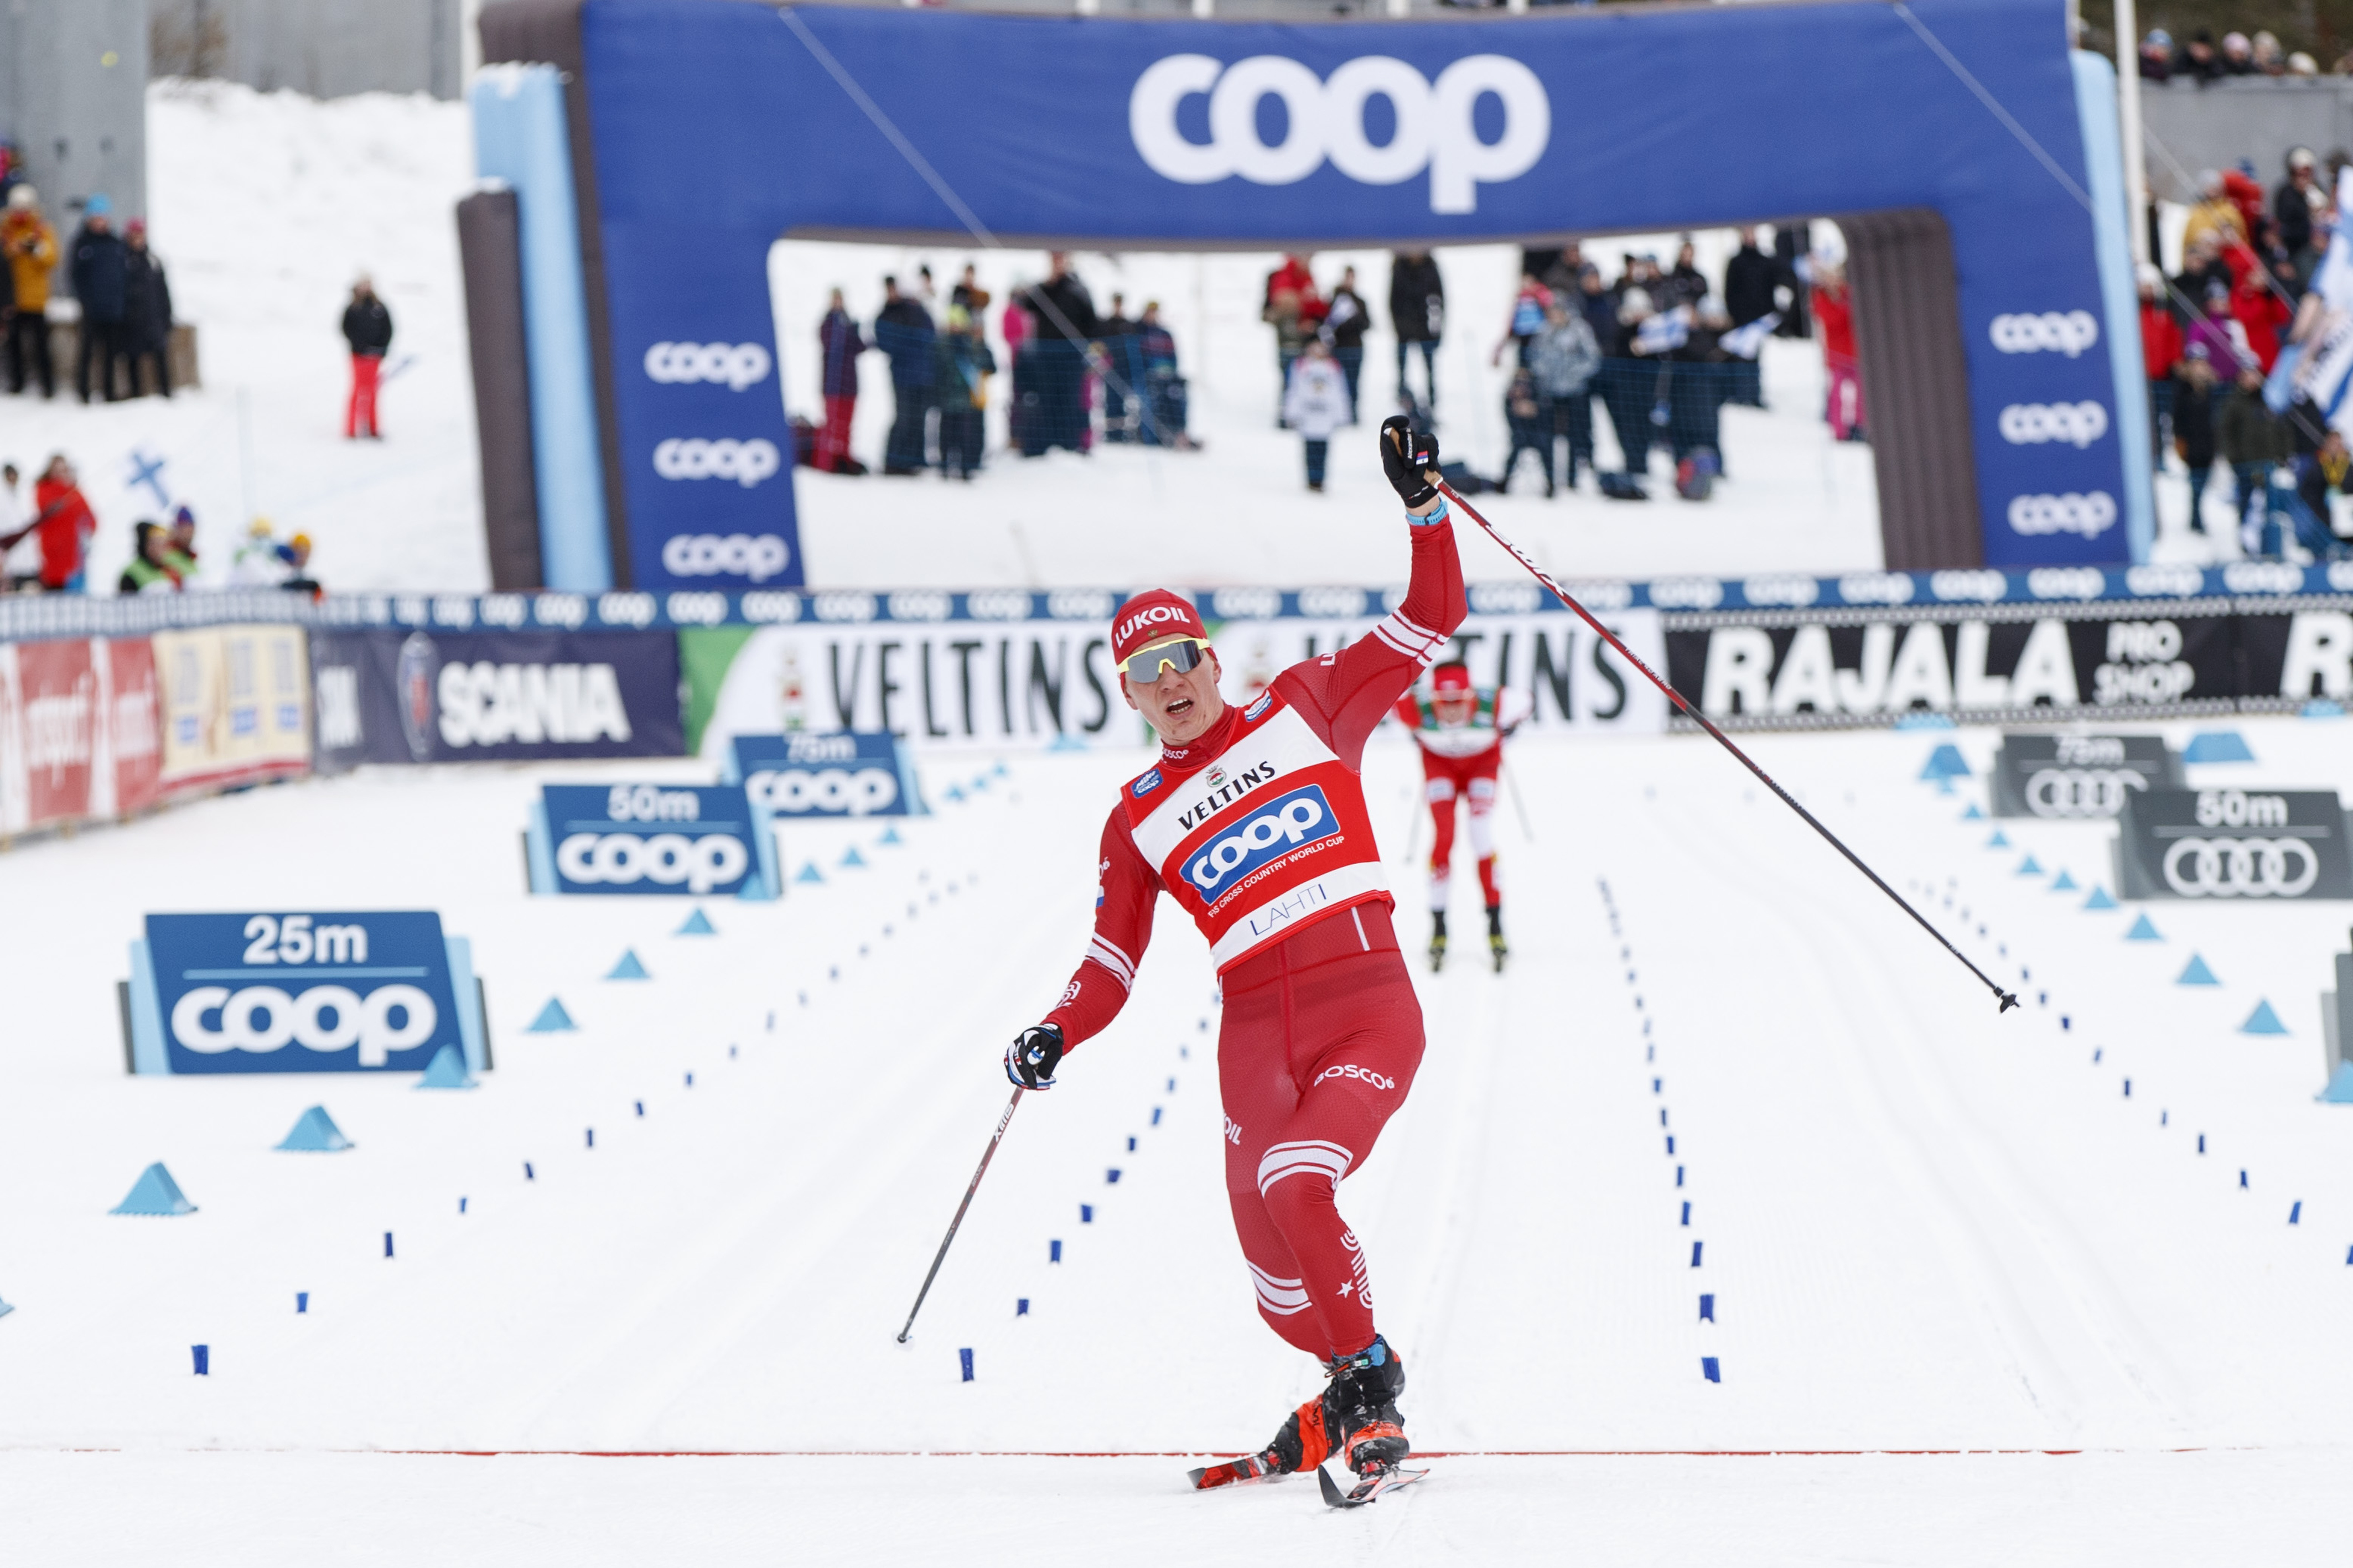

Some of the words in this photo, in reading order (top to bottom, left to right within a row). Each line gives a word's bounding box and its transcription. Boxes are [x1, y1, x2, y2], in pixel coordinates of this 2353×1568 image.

[1128, 53, 1552, 215] coop
[1989, 309, 2099, 359] coop
[644, 341, 771, 393] coop
[1998, 399, 2109, 449] coop
[653, 438, 781, 489] coop
[2008, 490, 2117, 541] coop
[661, 533, 790, 583] coop
[1116, 606, 1190, 648] LUKOIL
[2106, 619, 2183, 662] PRO
[828, 637, 1110, 738] VELTINS
[1701, 615, 2080, 718] RAJALA
[2093, 661, 2195, 707] SHOP
[438, 661, 633, 747] SCANIA
[786, 734, 857, 764] 75m
[2055, 734, 2126, 765] 75m
[607, 784, 701, 822] 50m
[745, 768, 898, 817] coop
[1178, 761, 1276, 831] VELTINS
[2195, 790, 2289, 827] 50m
[557, 832, 748, 894] coop
[1191, 798, 1323, 890] coop
[1207, 906, 1220, 918] FIS
[1219, 886, 1244, 908] CROSS
[1243, 859, 1288, 889] COUNTRY
[1288, 843, 1325, 863] WORLD
[1326, 835, 1345, 848] CUP
[1250, 884, 1326, 936] LAHTI
[242, 914, 369, 965] 25m
[171, 983, 437, 1067] coop
[1314, 1064, 1386, 1090] BOSCO
[1223, 1112, 1243, 1145] OIL
